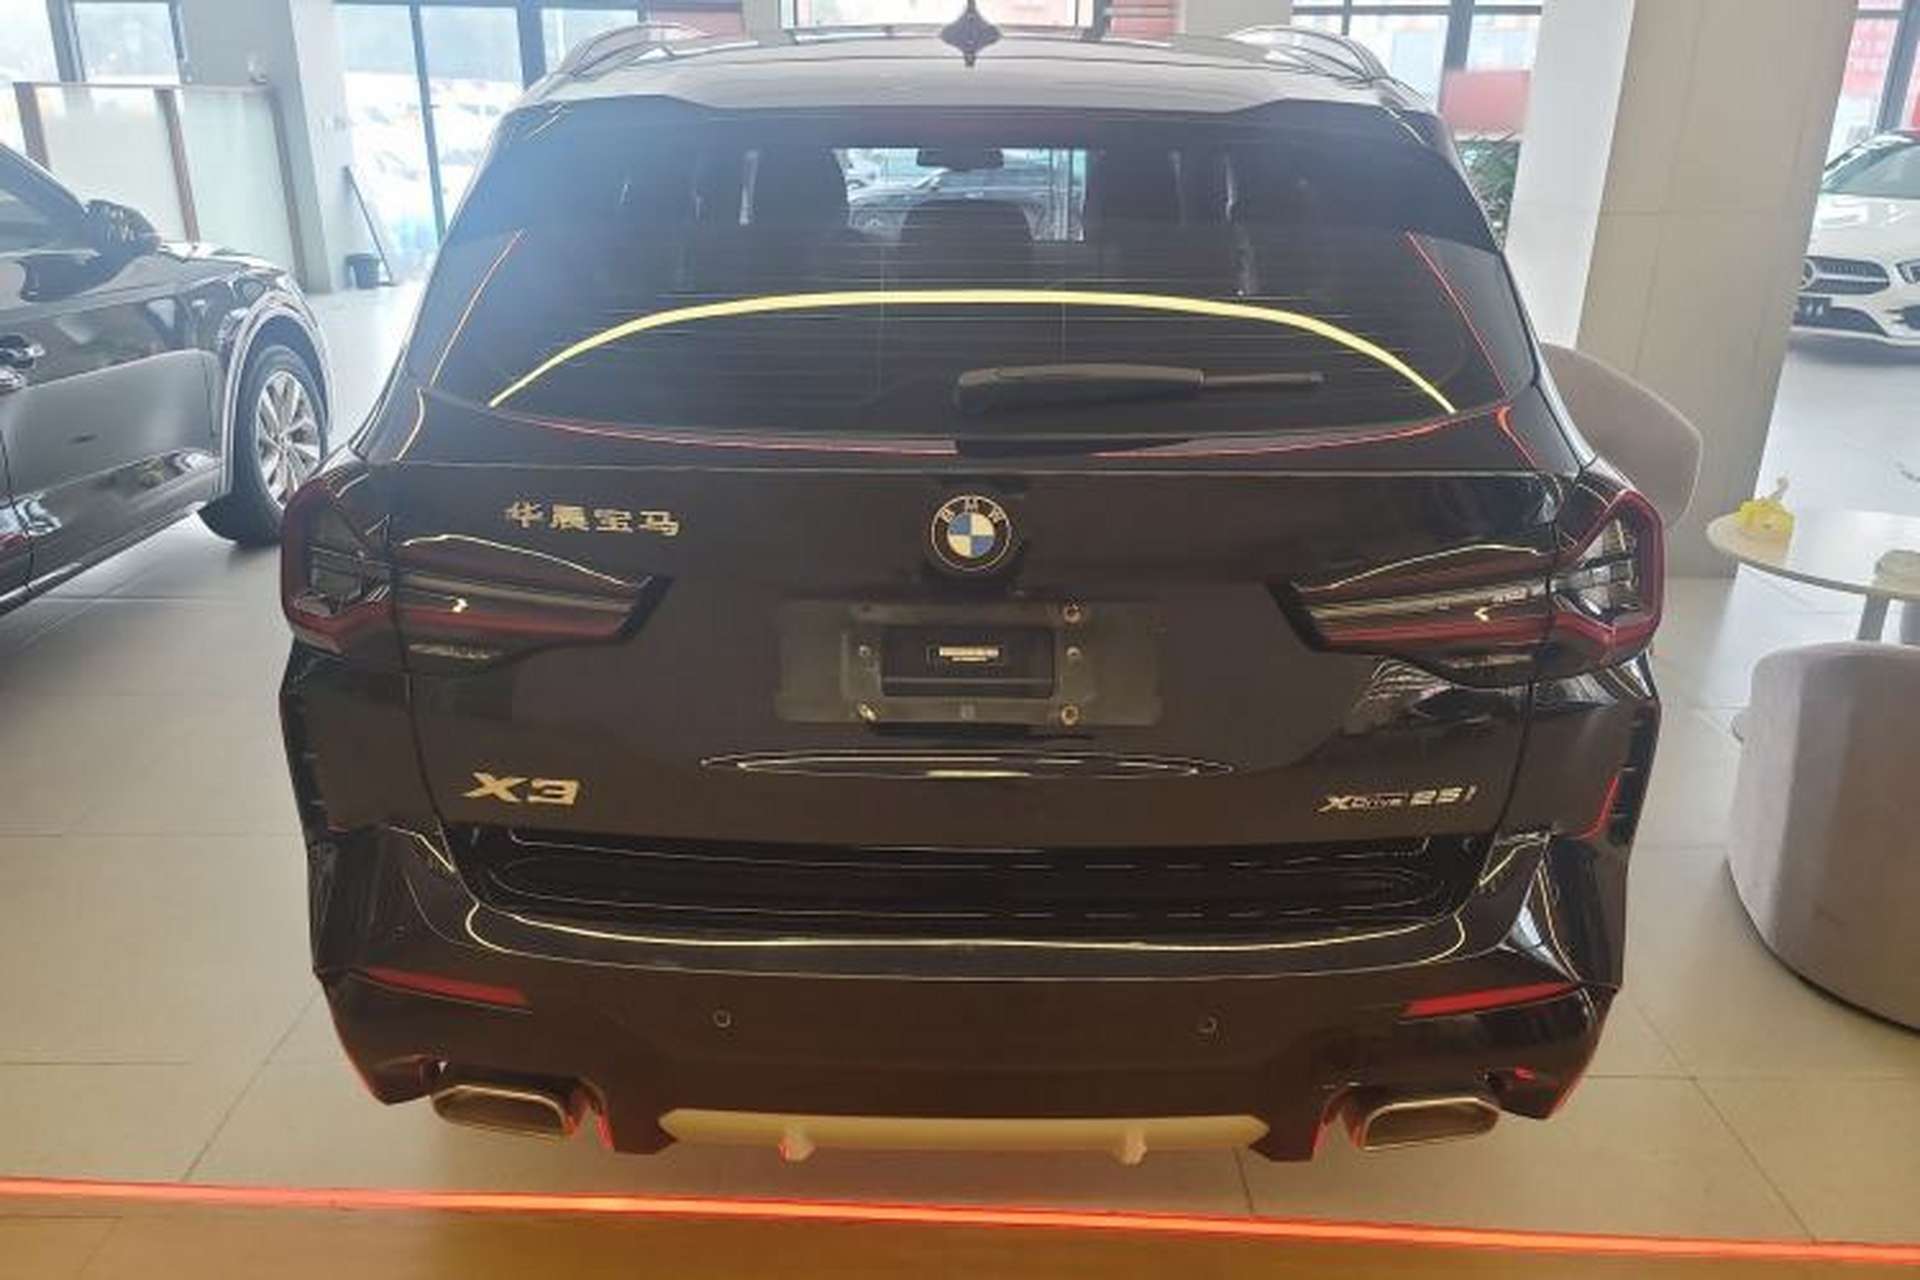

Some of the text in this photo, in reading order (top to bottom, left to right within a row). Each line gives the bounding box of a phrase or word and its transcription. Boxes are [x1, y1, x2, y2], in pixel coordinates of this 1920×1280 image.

[505, 502, 679, 536] 华晨宝马
[939, 498, 1007, 523] BMW
[462, 772, 579, 804] X3
